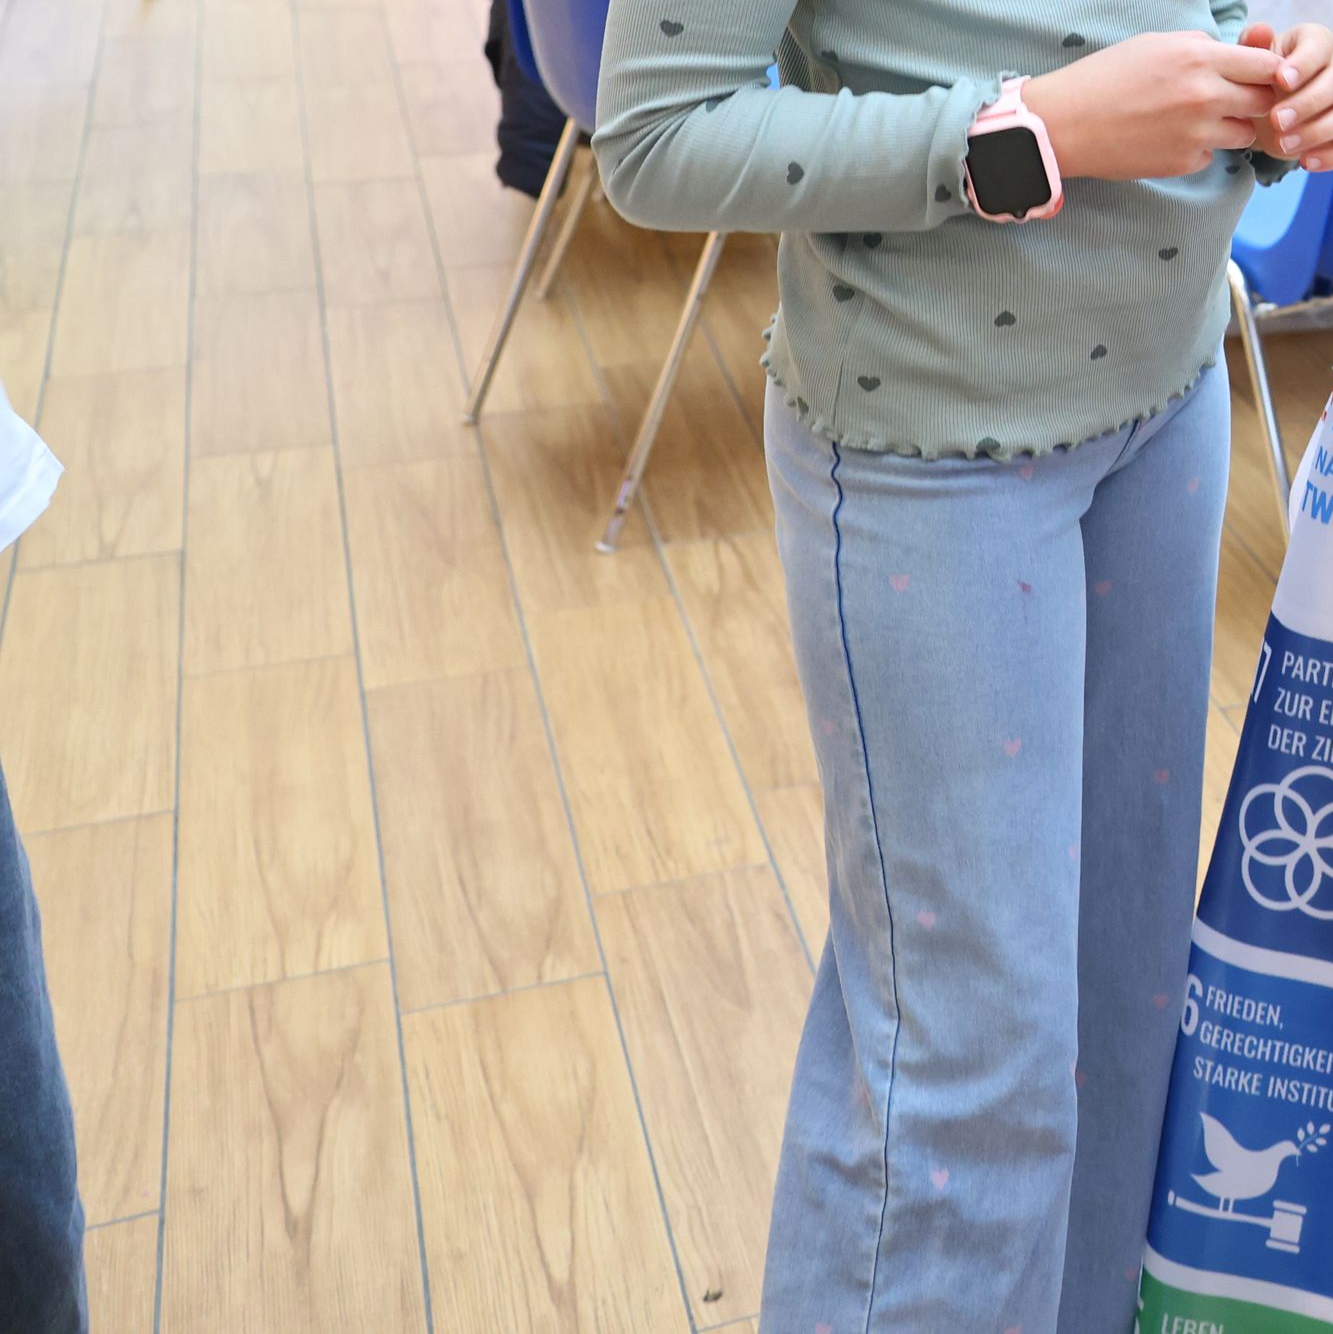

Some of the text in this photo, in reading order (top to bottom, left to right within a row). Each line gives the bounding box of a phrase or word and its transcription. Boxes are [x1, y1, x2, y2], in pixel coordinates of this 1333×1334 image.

[1273, 686, 1314, 722] ZUR
[1267, 723, 1307, 758] DER
[1205, 985, 1284, 1030] FRIEDEN,
[1193, 1056, 1262, 1096] STARKE
